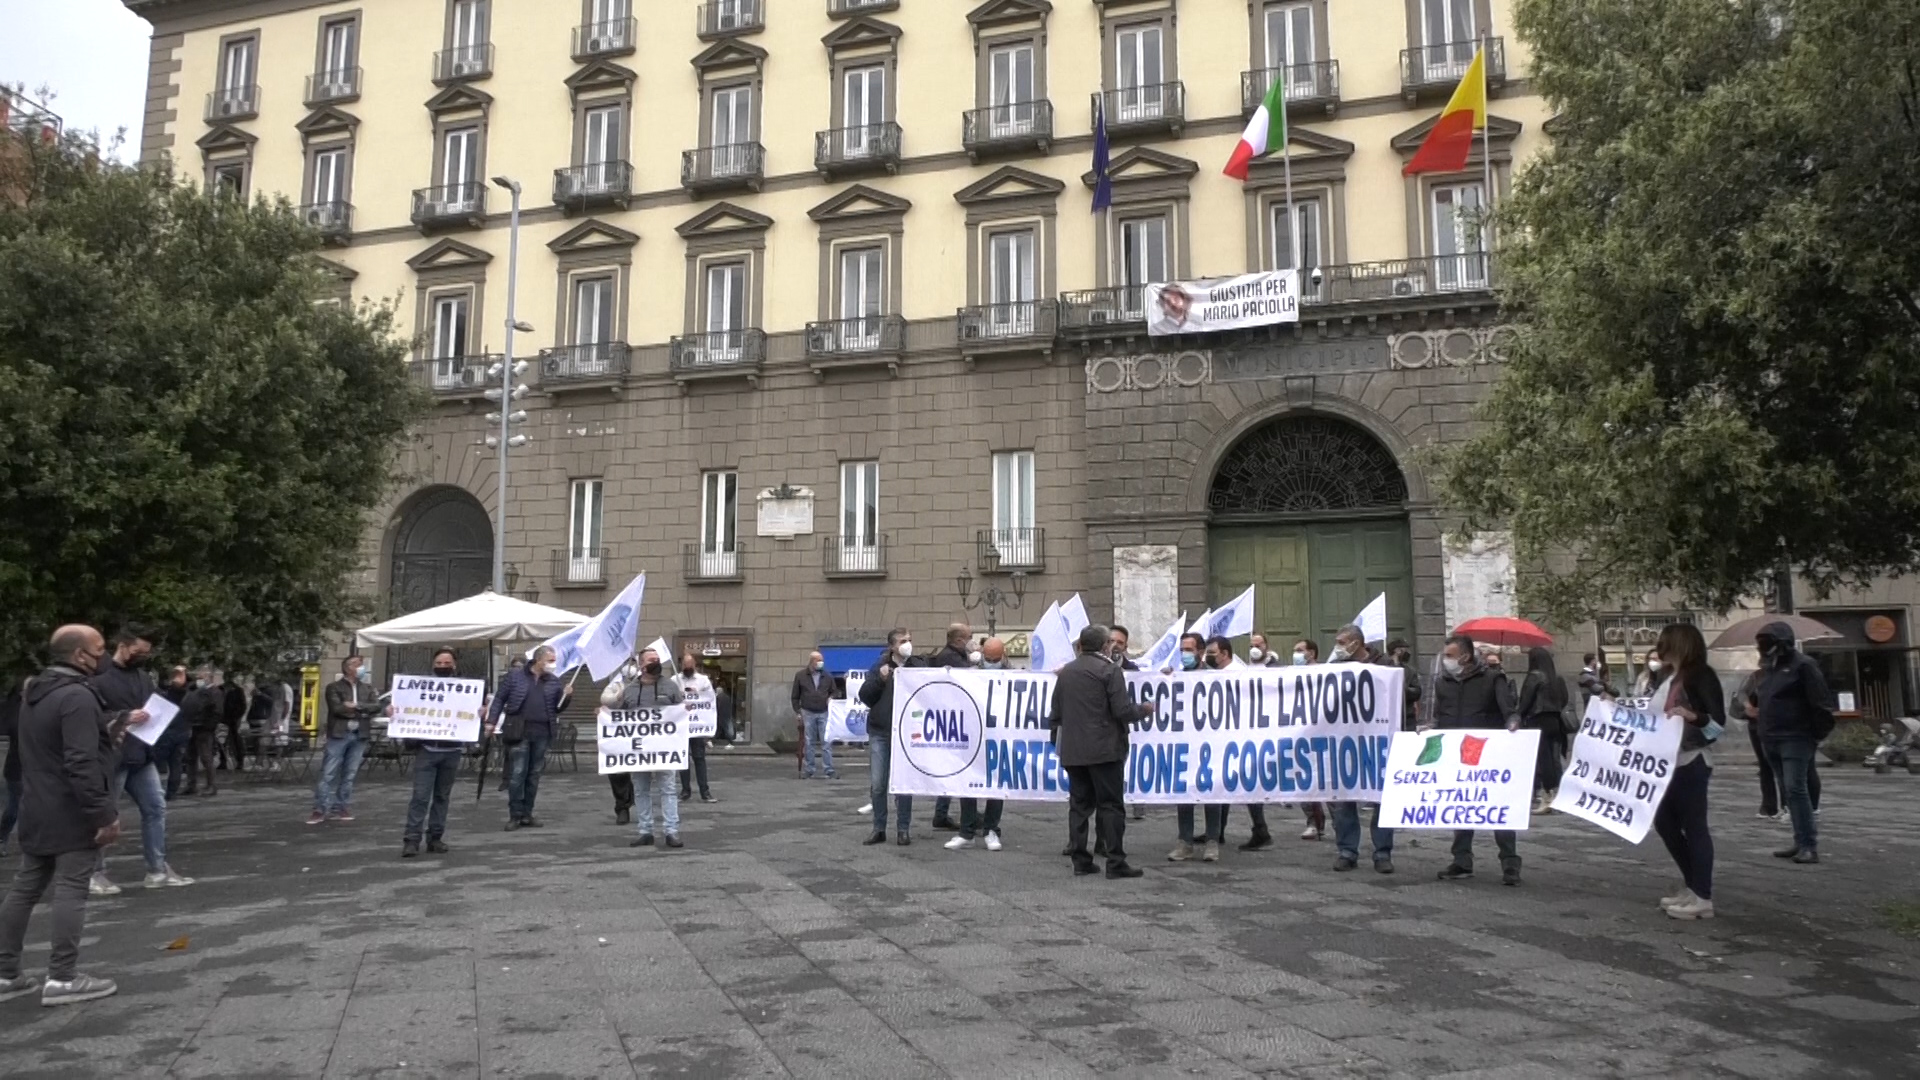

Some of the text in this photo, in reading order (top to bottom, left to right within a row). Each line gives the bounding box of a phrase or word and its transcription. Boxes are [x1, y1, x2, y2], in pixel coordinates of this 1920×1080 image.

[1210, 279, 1287, 303] GIUSTIZIA PER
[1203, 295, 1296, 322] MARIO PACIOLLA
[985, 669, 1389, 732] L'ITAL ASCE CON IL LAVORO...
[611, 709, 663, 722] BROS
[922, 709, 969, 742] CNAL
[602, 721, 677, 738] LAVORO
[1580, 717, 1636, 747] PLATEA
[631, 737, 643, 750] E
[605, 750, 686, 767] DIGNITA'
[1195, 741, 1213, 792] &
[1222, 735, 1388, 792] COGESTIONE
[1618, 749, 1669, 778] BROS
[1393, 768, 1511, 785] SENZA LAVORO
[1572, 759, 1657, 803] 20 ANNI DI
[1420, 786, 1488, 803] L'ITALIA
[1400, 805, 1510, 825] NON CRESCE
[1575, 791, 1634, 828] ATTESA
